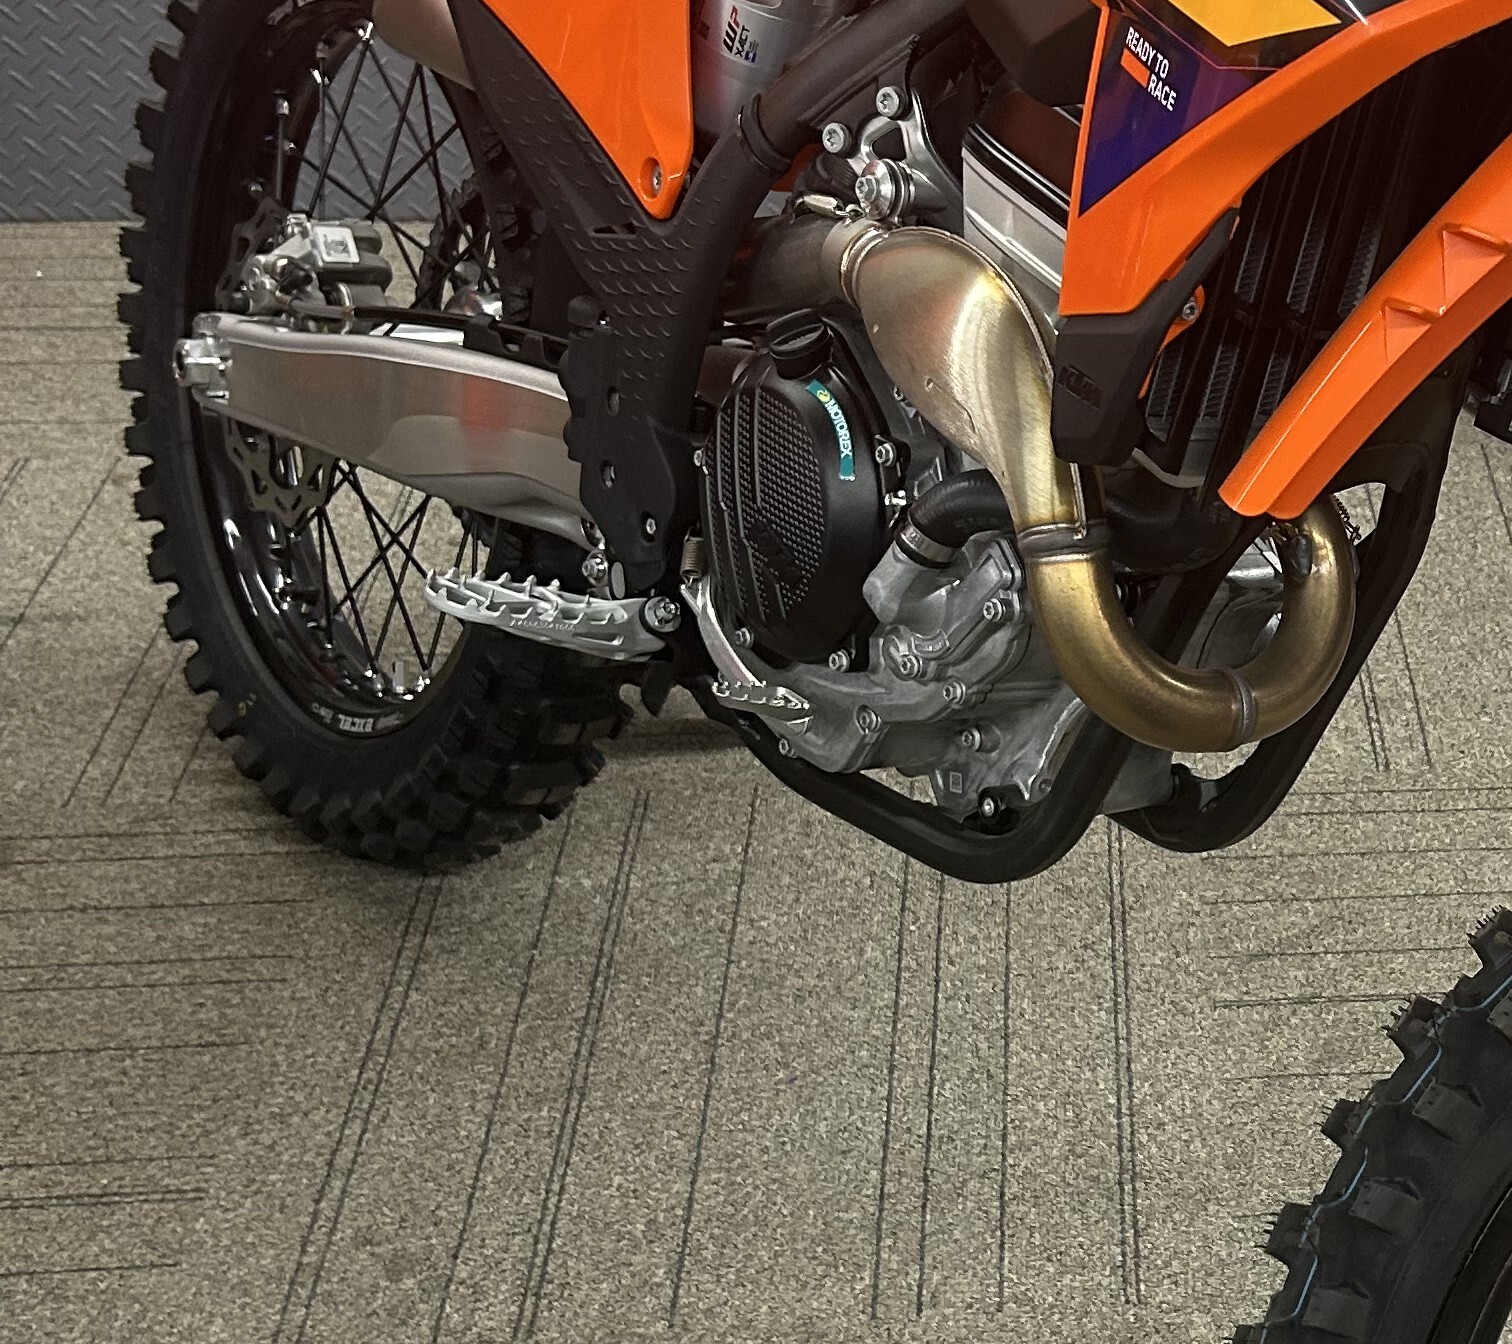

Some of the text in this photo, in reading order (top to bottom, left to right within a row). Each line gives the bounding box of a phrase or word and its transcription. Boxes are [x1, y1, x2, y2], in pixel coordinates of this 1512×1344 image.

[722, 4, 740, 54] WP
[734, 24, 751, 58] XACT
[1125, 26, 1170, 79] READY TO
[1147, 73, 1177, 112] RACE
[824, 398, 853, 459] MOTOREX
